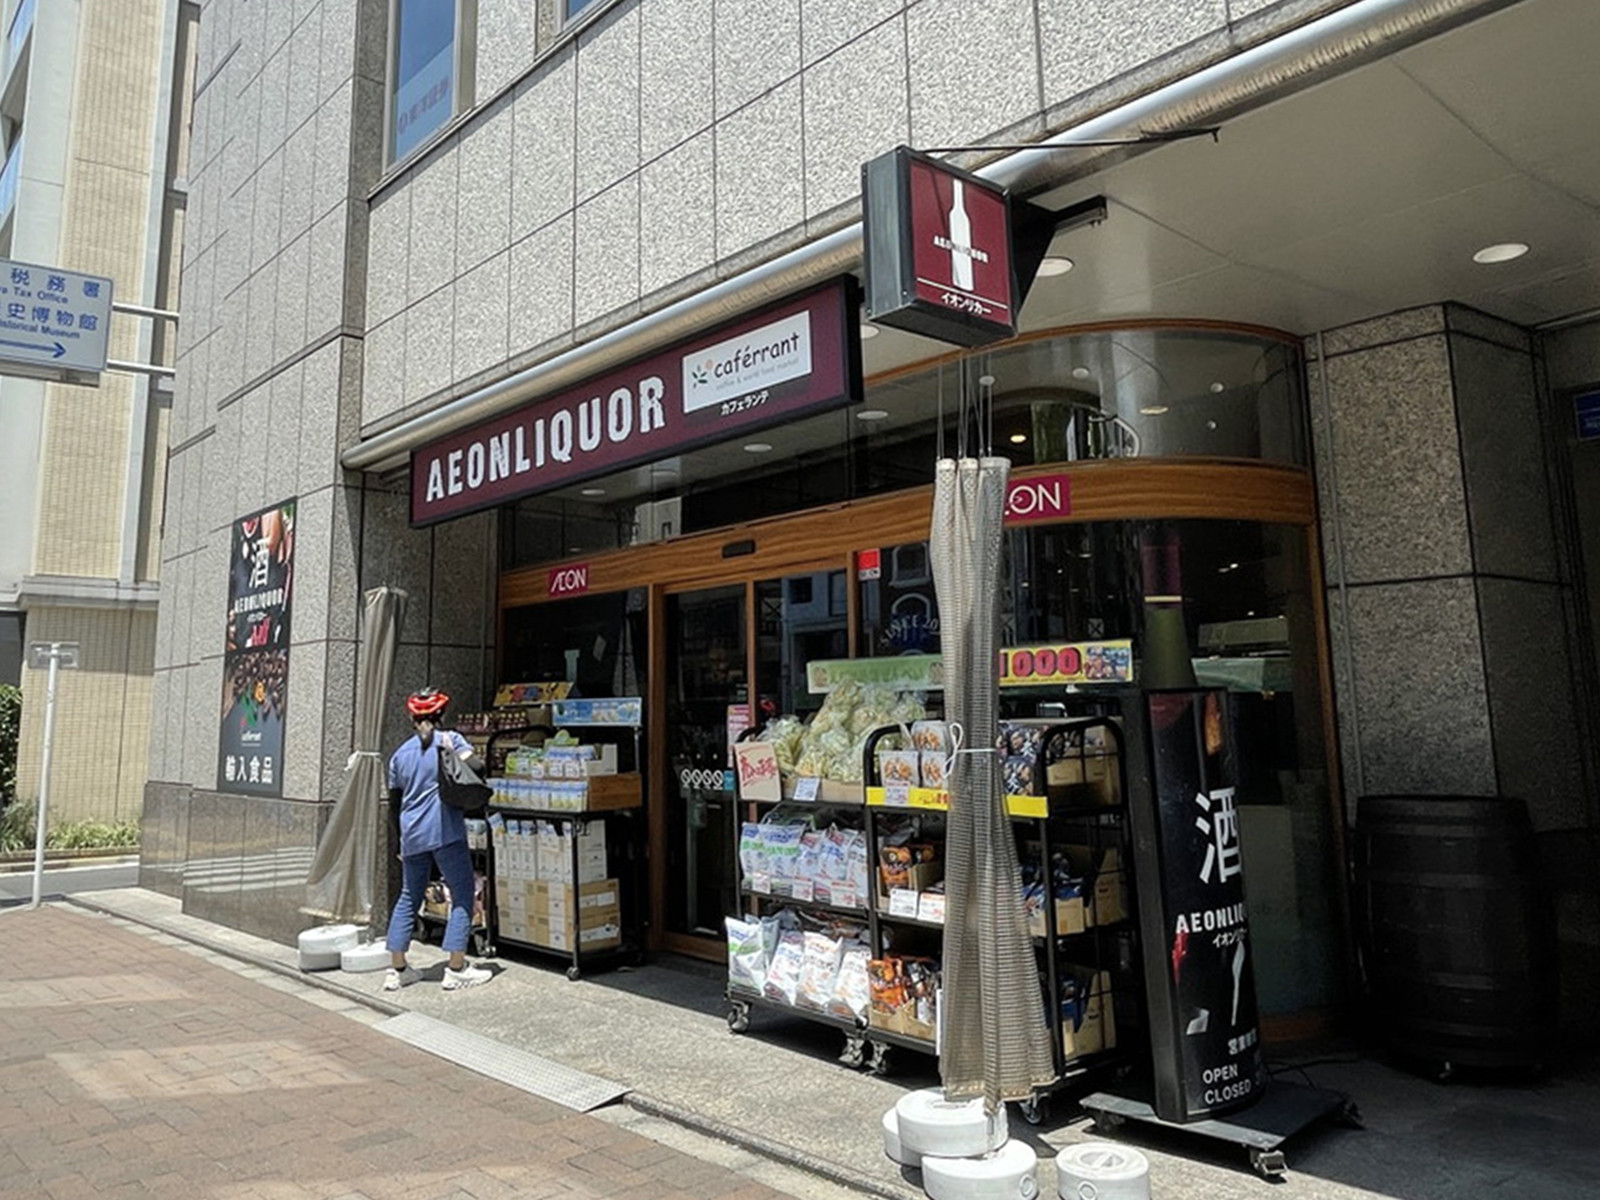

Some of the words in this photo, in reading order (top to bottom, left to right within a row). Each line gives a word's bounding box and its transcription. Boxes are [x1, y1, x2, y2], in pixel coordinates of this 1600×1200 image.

[714, 331, 799, 378] caférrant
[426, 376, 666, 502] AEONLIQUOR
[1202, 1063, 1239, 1084] OPEN
[1204, 1079, 1252, 1105] CLOSED
